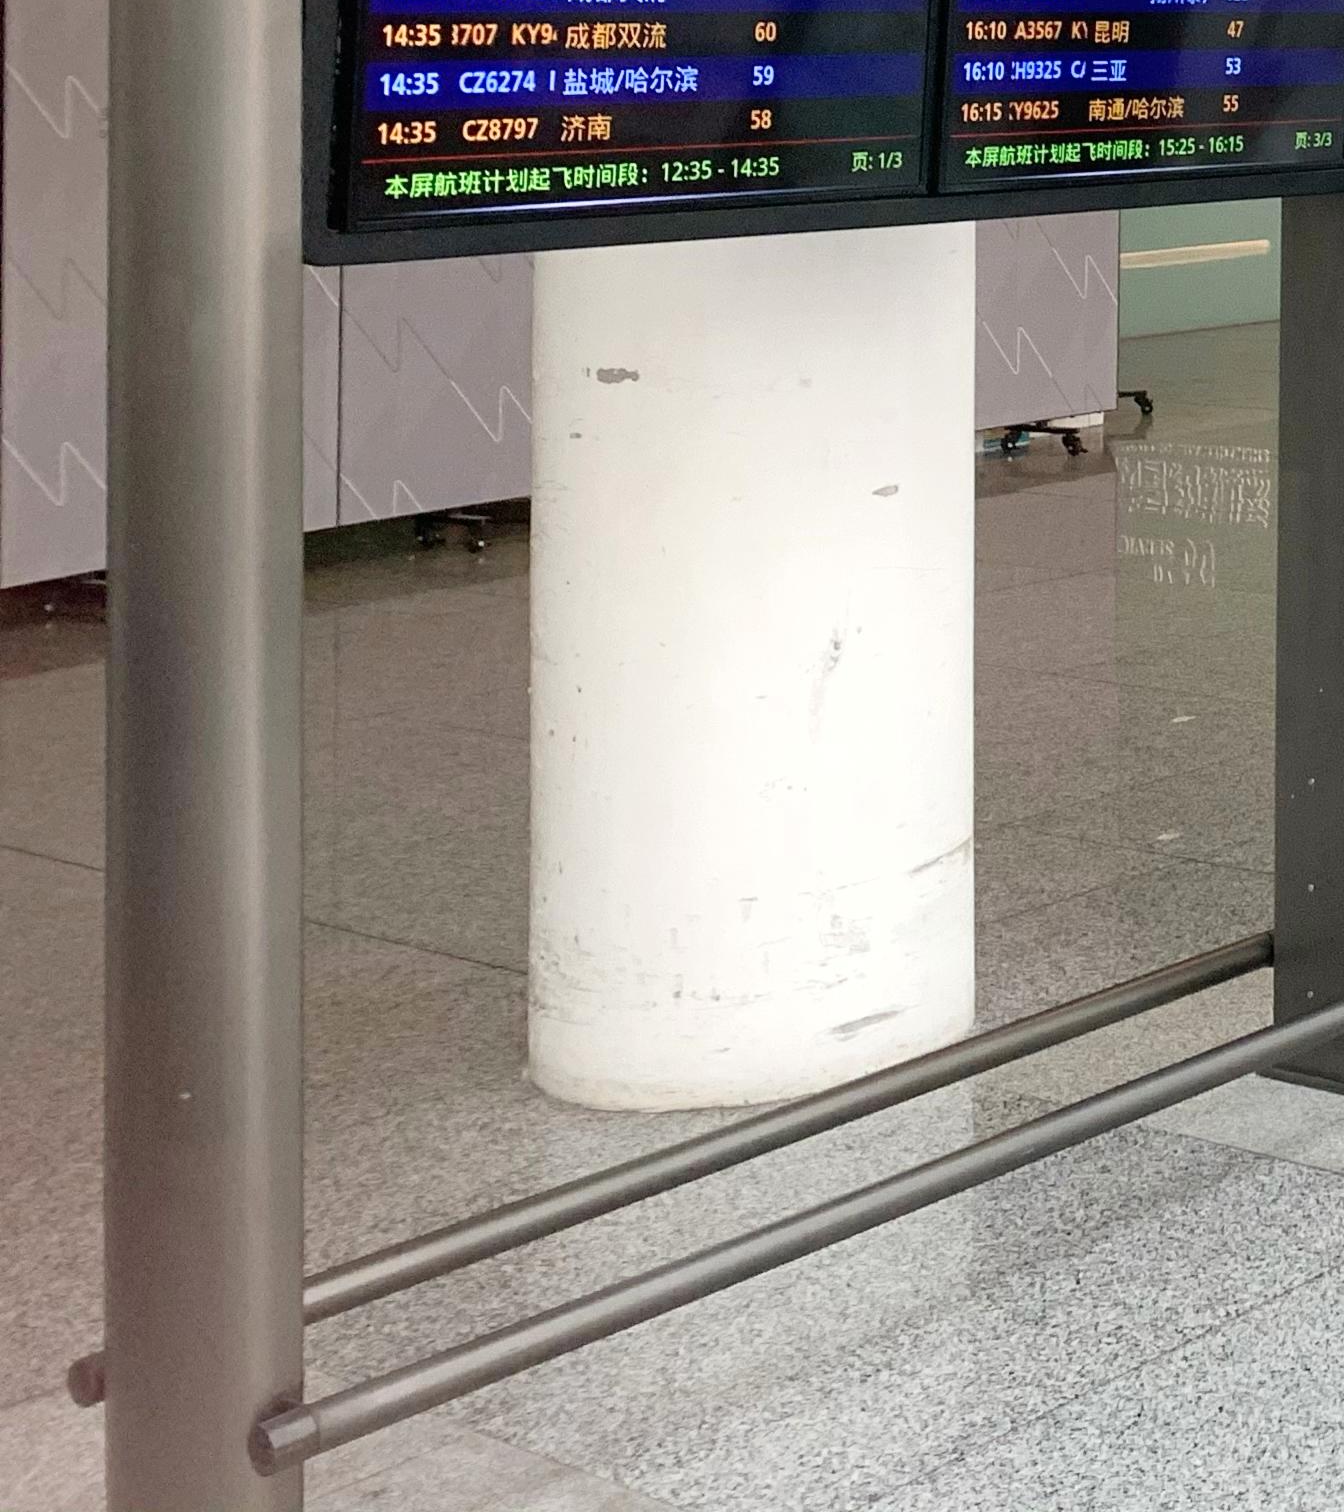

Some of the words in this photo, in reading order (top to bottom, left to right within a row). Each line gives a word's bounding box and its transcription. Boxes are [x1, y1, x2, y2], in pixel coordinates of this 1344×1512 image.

[965, 20, 1007, 40] 16:10
[1093, 19, 1130, 43] 昆明
[1226, 20, 1244, 37] 47
[379, 71, 439, 96] 14:35
[458, 70, 536, 93] CZ6274
[562, 65, 698, 95] 盐城/哈尔滨
[752, 64, 774, 86] 59
[960, 101, 1002, 122] 16:15
[1008, 99, 1059, 120] Y9625
[1088, 95, 1184, 122] 南通/哈尔滨
[1222, 94, 1239, 112] 55
[377, 120, 436, 145] 14:35
[461, 117, 538, 141] CZ8797
[560, 112, 612, 142] 济南
[750, 108, 771, 129] 58
[1159, 138, 1195, 156] 15:25
[1208, 135, 1244, 153] 16:15
[1312, 131, 1332, 149] 3/3
[662, 160, 713, 183] 12:35
[731, 155, 780, 178] 14:35
[877, 149, 903, 170] 1/3
